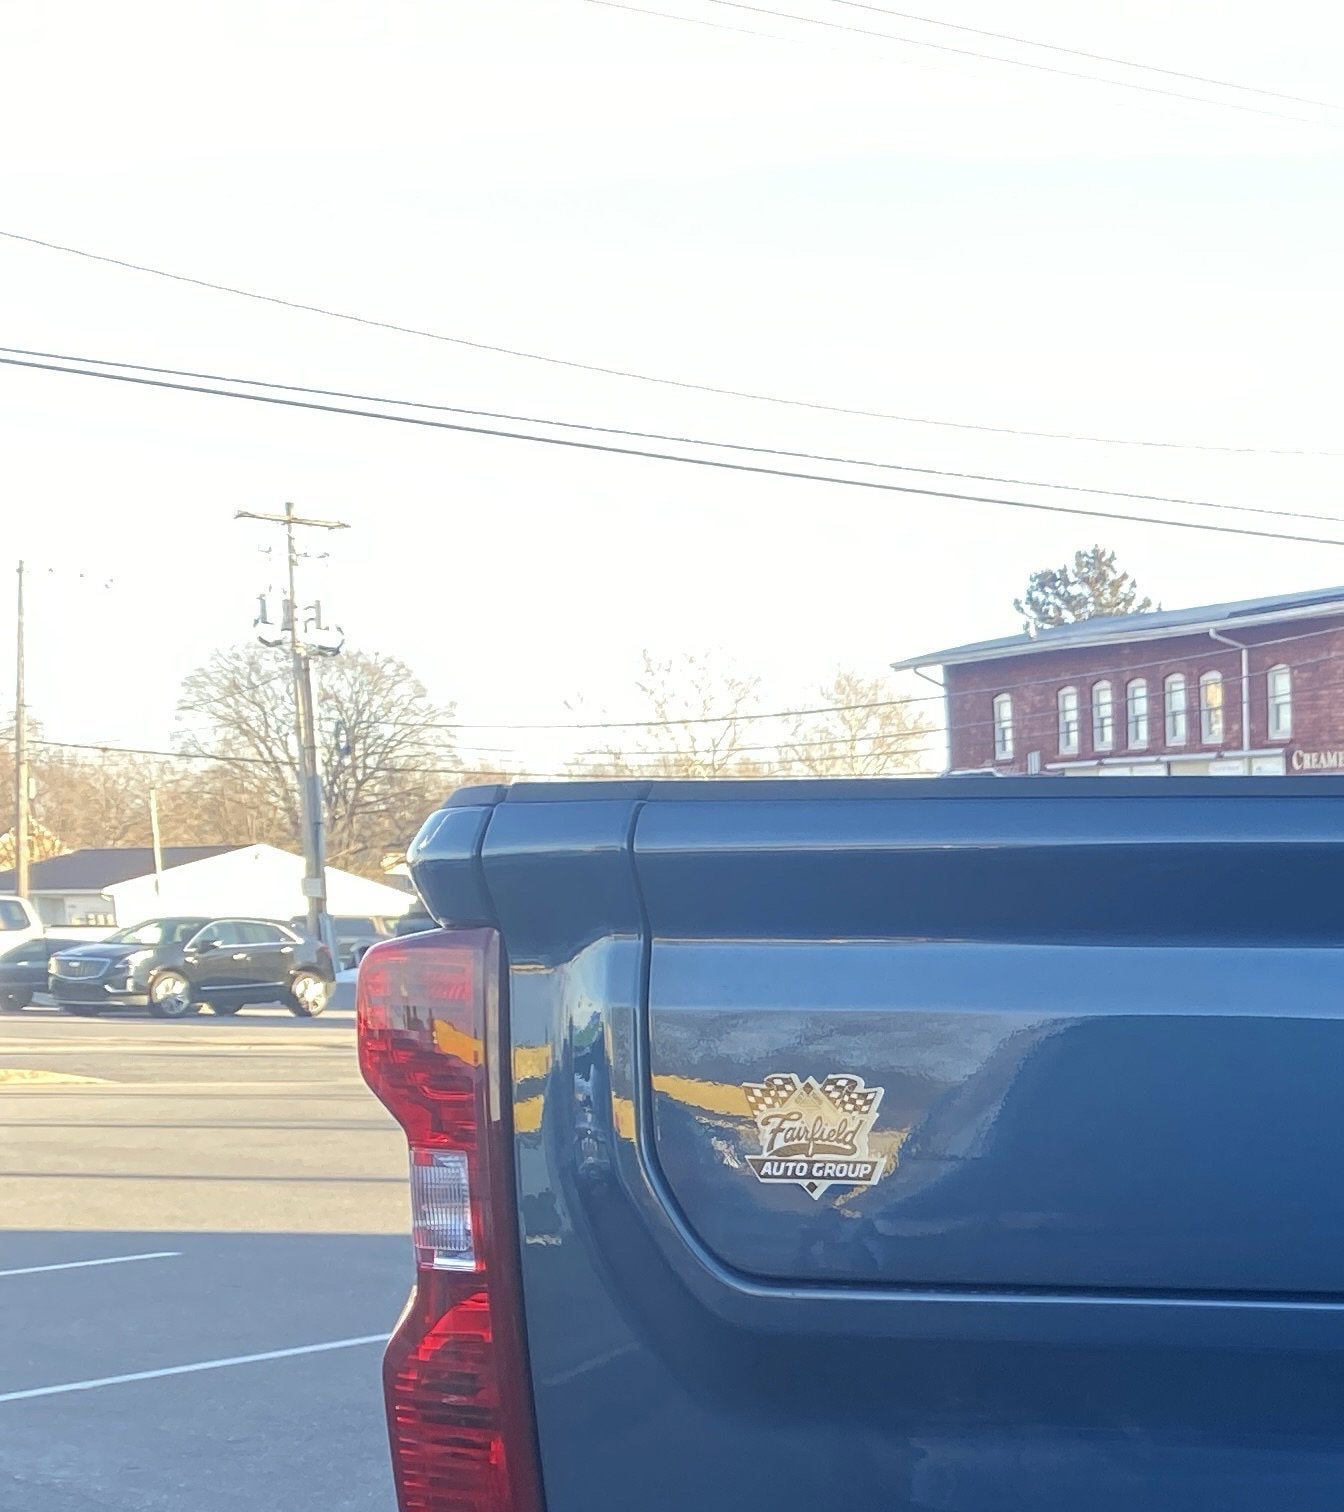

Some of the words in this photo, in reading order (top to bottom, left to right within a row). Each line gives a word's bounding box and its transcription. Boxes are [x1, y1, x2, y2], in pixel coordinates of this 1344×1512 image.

[761, 1111, 864, 1157] Fairfield
[760, 1161, 808, 1177] AUTO
[812, 1162, 872, 1178] GROUP
